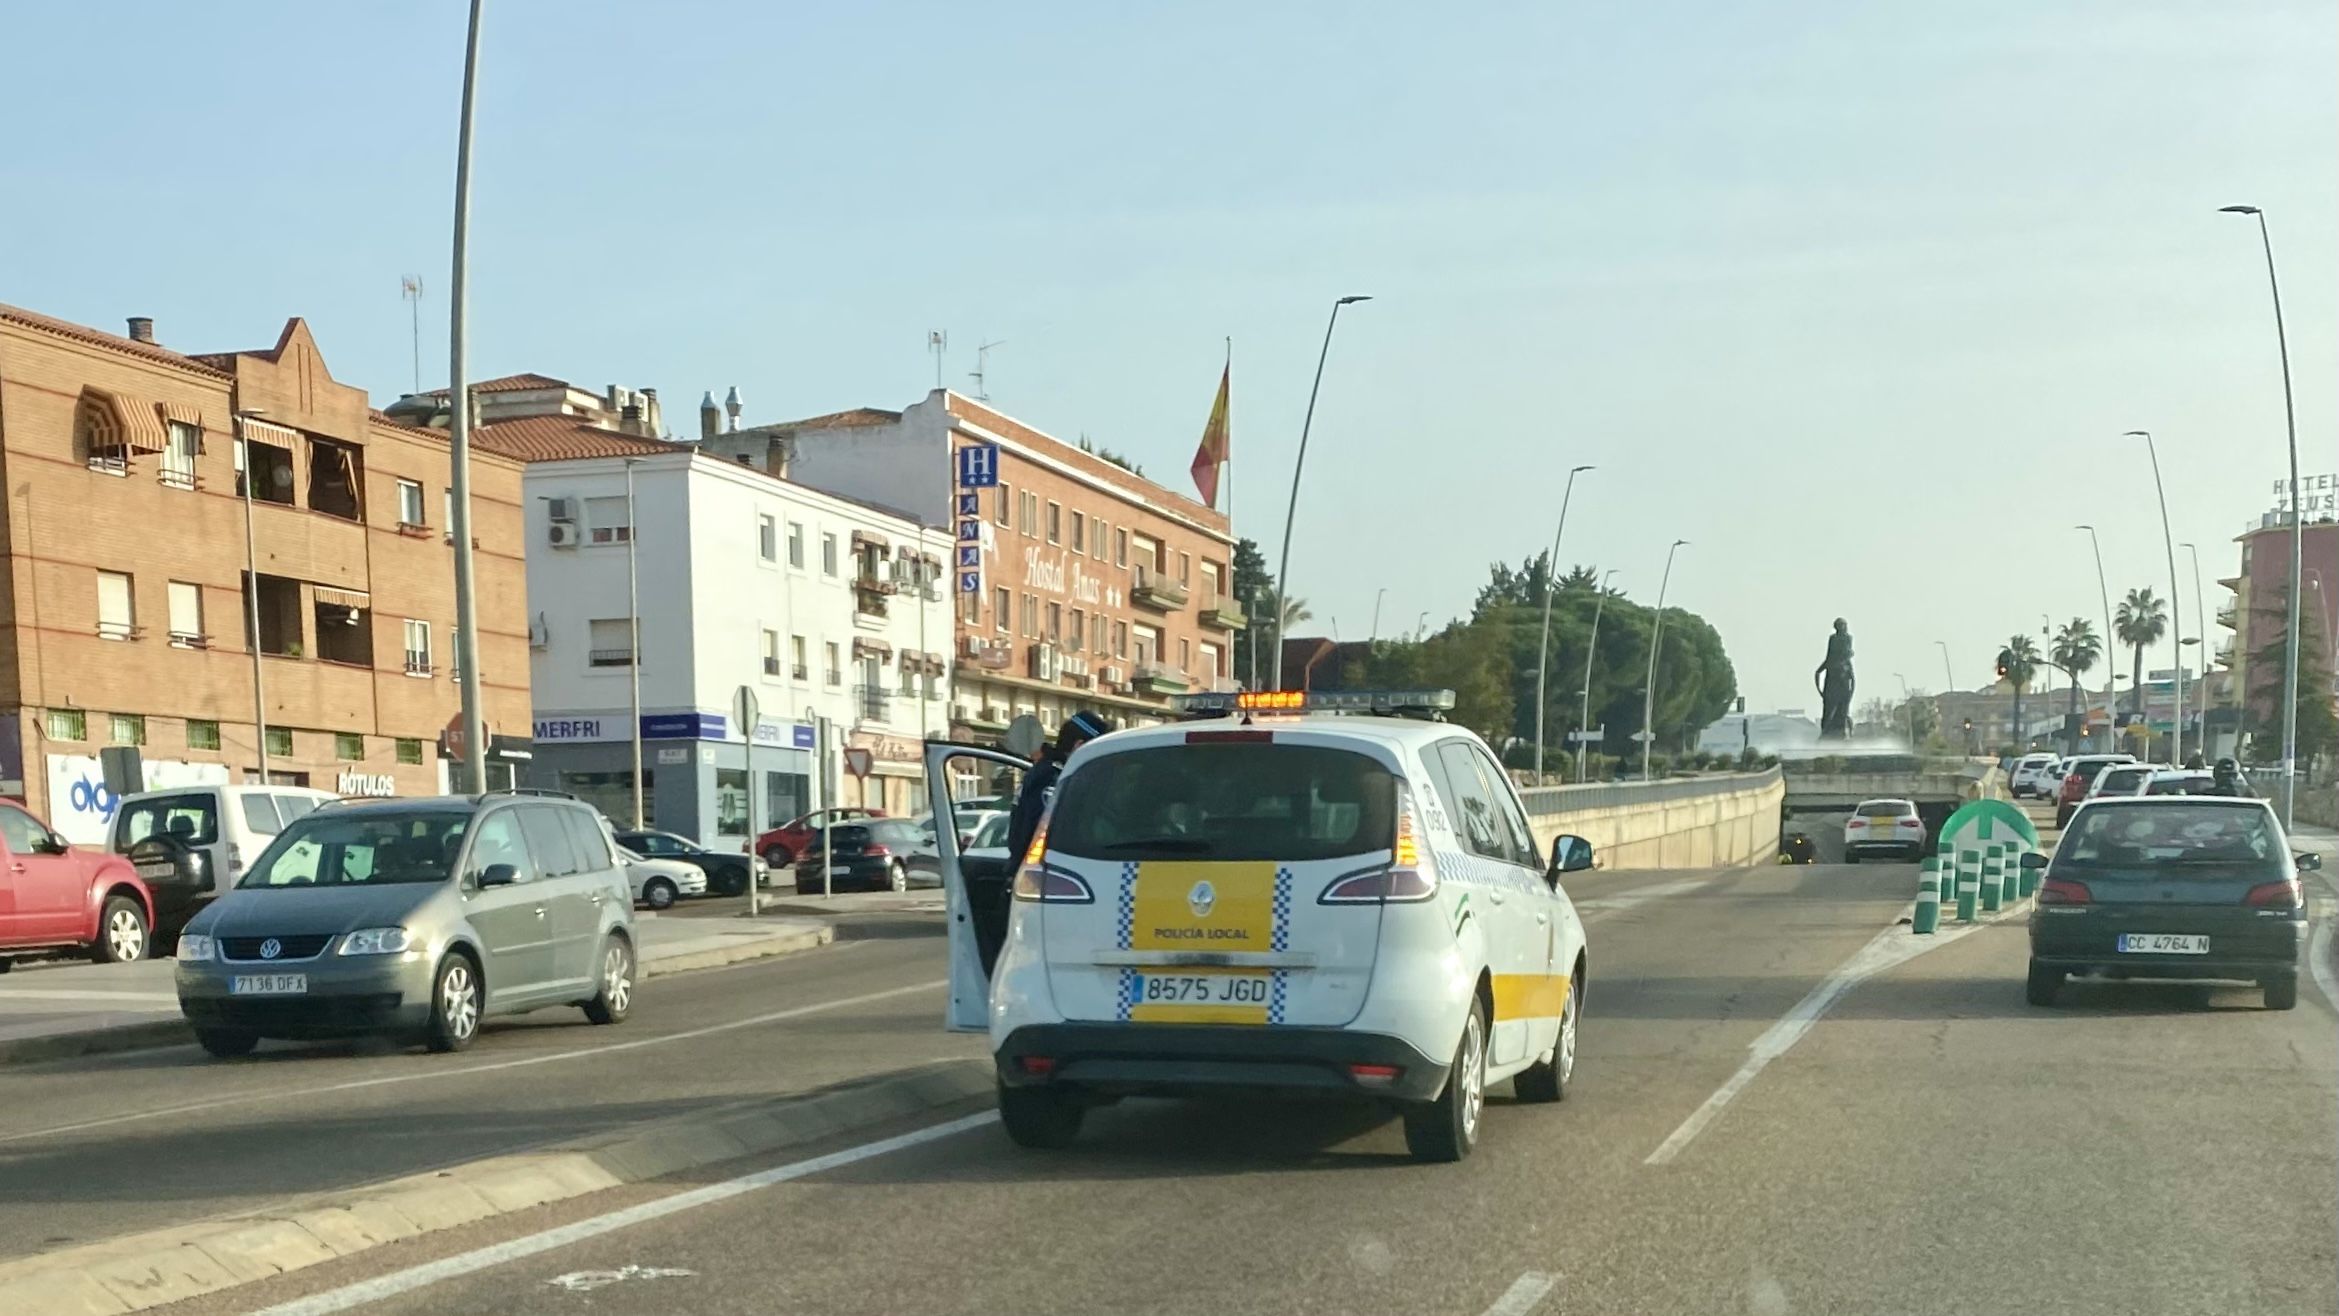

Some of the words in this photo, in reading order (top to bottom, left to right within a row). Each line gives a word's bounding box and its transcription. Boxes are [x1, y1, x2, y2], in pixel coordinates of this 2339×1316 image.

[967, 447, 992, 475] H
[1024, 545, 1068, 594] Hostal
[532, 720, 600, 738] MERFRI
[338, 765, 395, 796] RÓTULOS
[1207, 928, 1249, 939] LOCAL
[2127, 936, 2146, 950] CC
[2153, 936, 2190, 950] 4764
[2197, 938, 2208, 951] N
[1148, 978, 1209, 1000] 8575
[1219, 979, 1267, 1002] JGD
